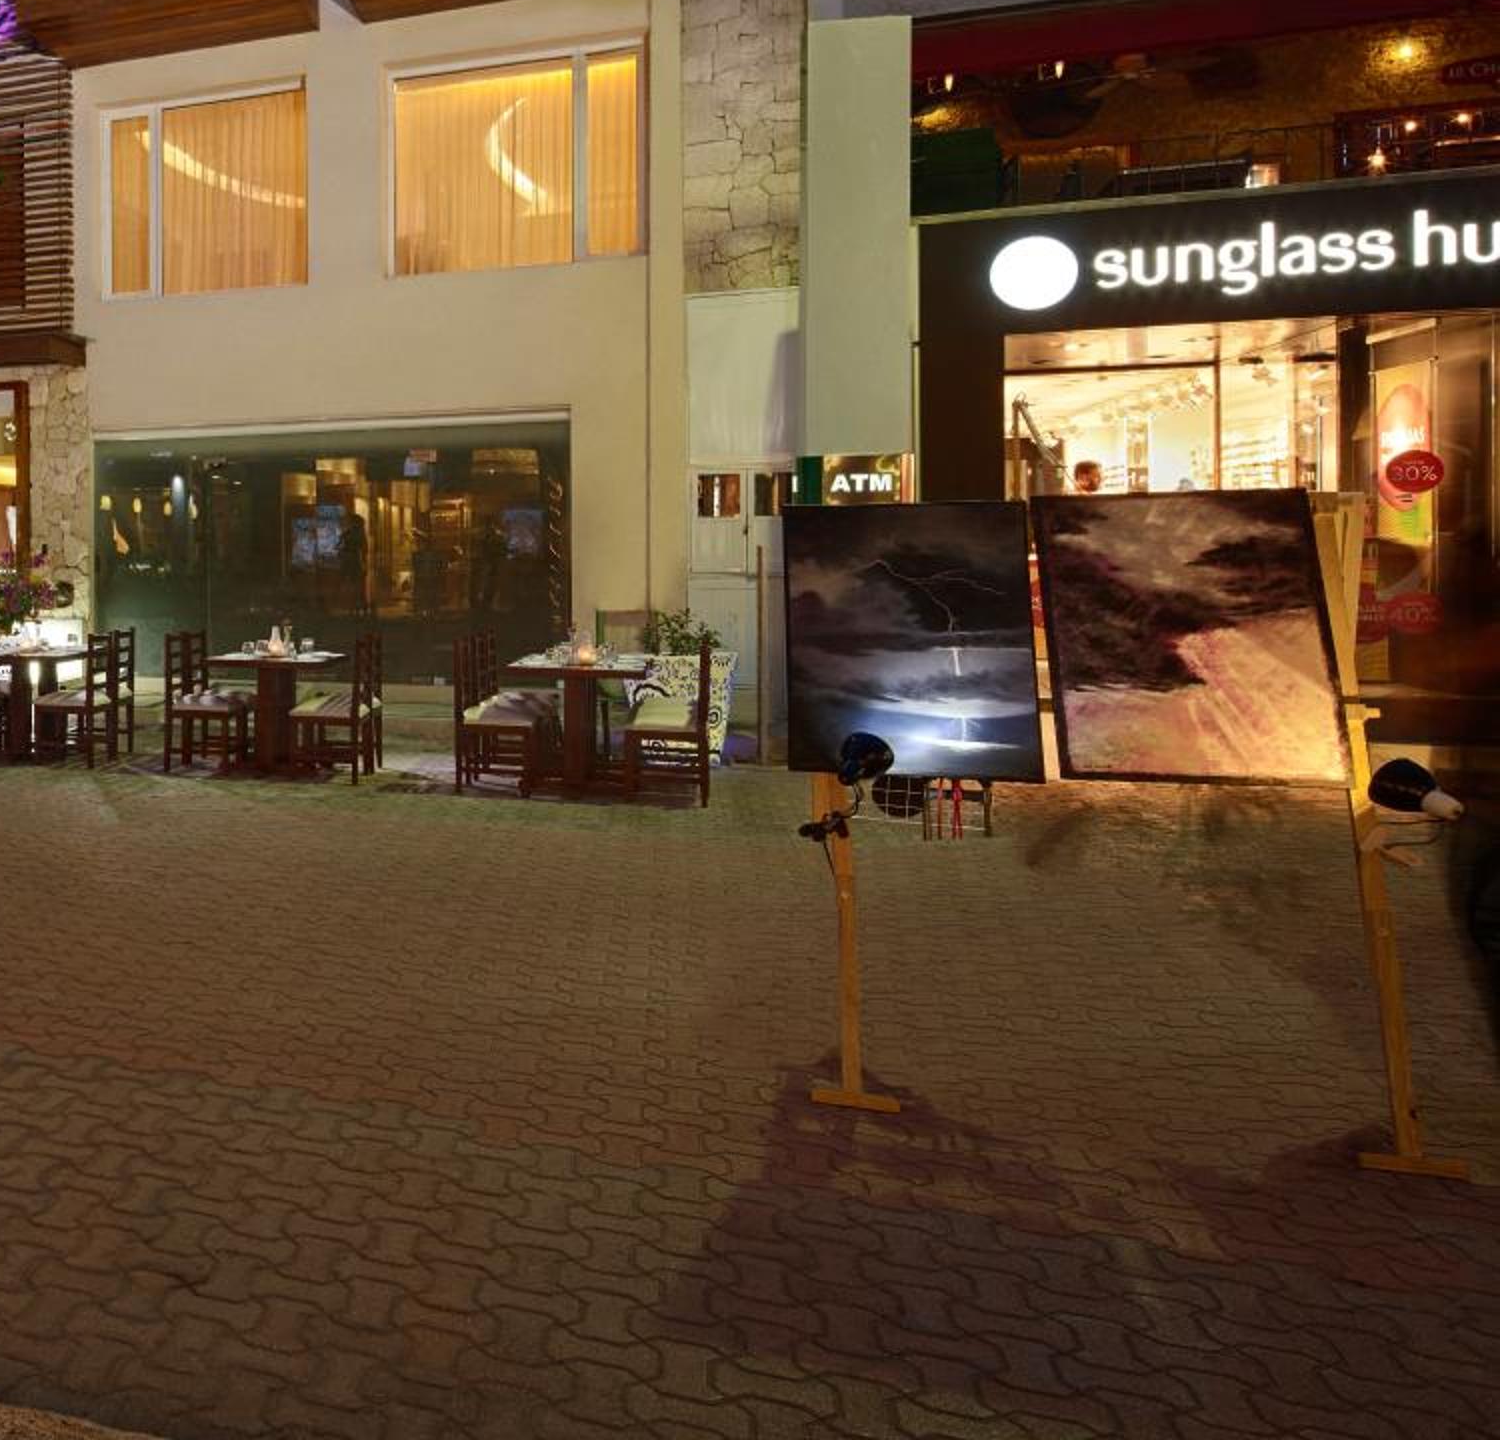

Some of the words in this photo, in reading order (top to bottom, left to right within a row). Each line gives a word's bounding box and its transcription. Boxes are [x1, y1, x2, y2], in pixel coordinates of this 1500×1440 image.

[1094, 222, 1396, 296] sunglass
[1413, 208, 1500, 268] hu
[830, 473, 892, 492] ATM
